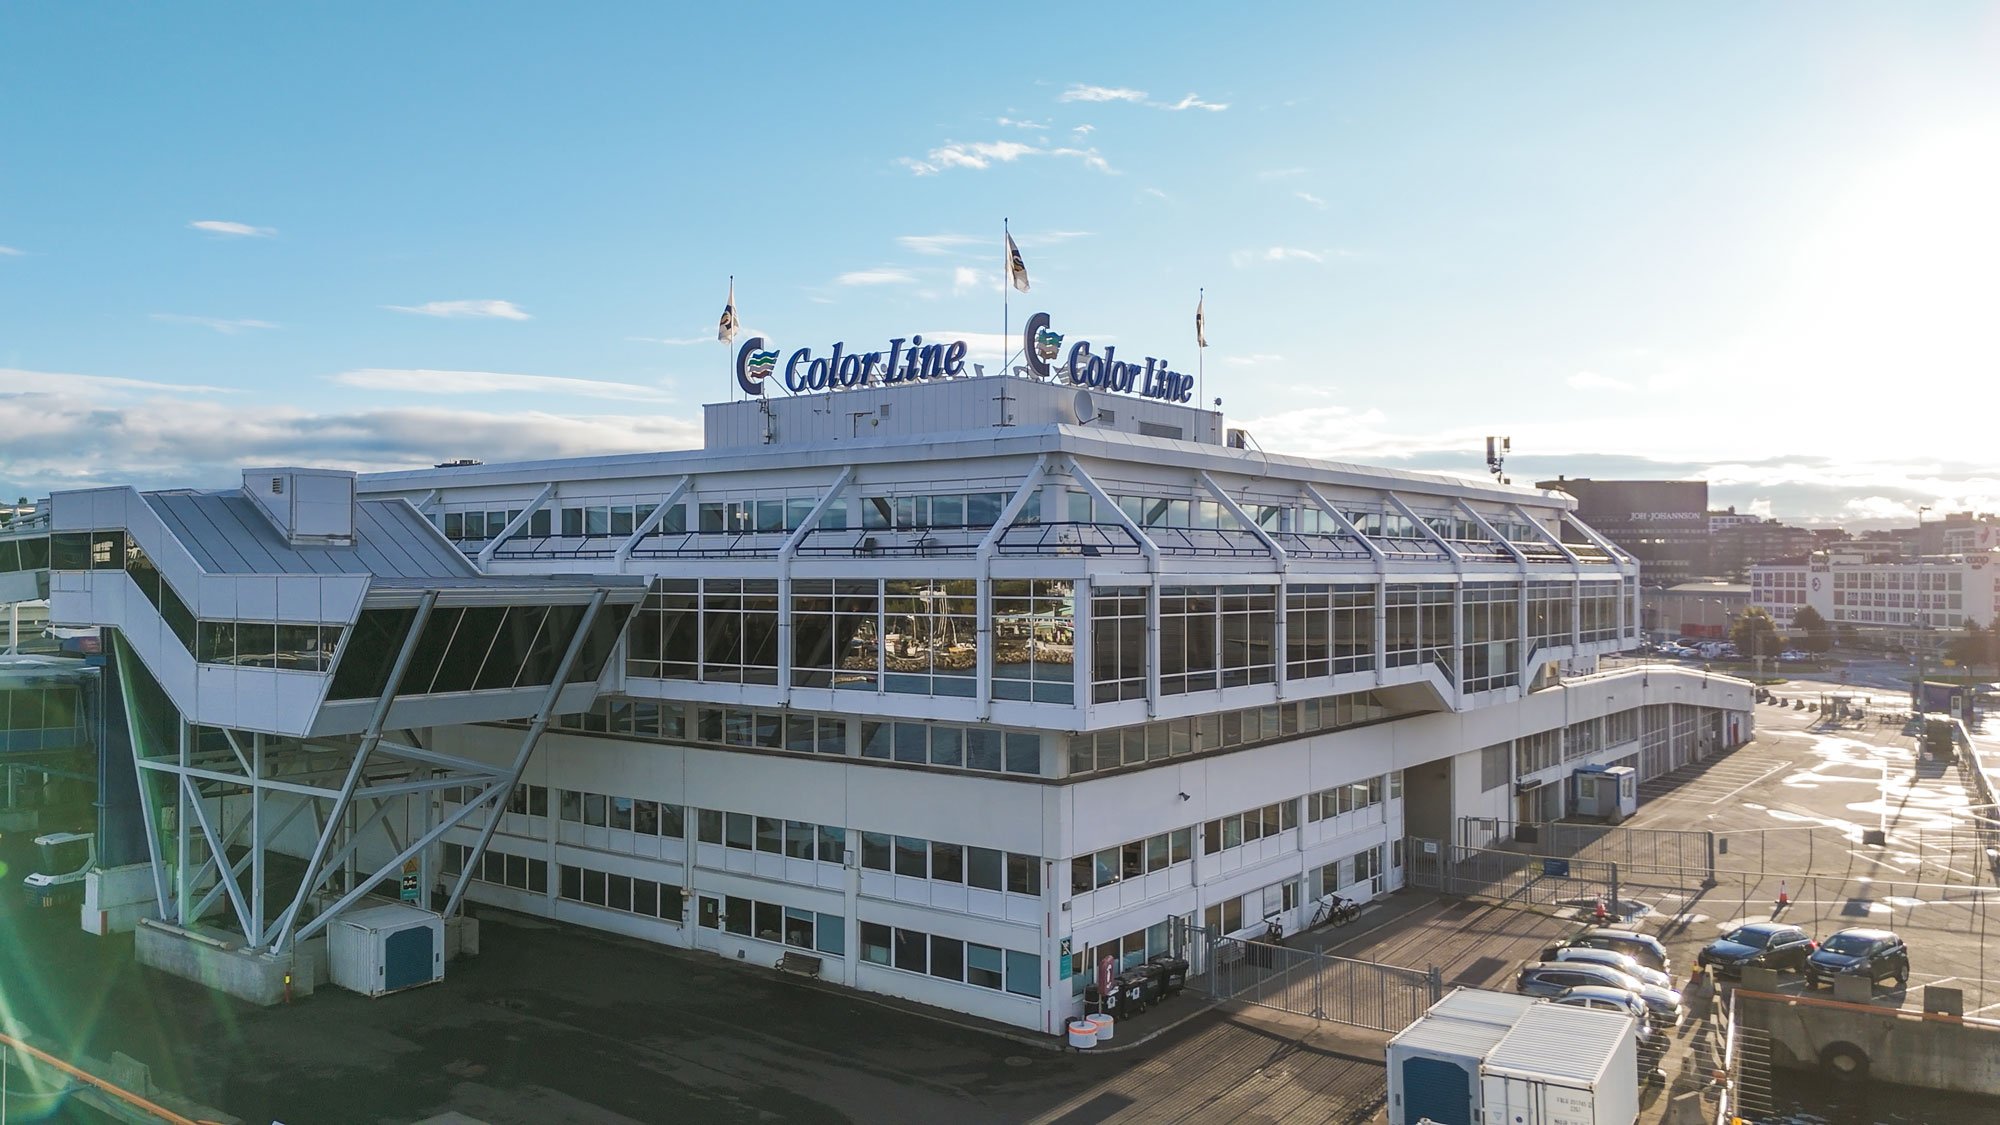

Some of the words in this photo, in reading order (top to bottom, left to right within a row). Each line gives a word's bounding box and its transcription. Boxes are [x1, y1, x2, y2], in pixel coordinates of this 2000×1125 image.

[785, 341, 881, 392] Color
[883, 335, 967, 383] Line
[1068, 341, 1141, 393] Color
[1142, 356, 1194, 403] Line
[1649, 512, 1700, 521] JOHANNSON
